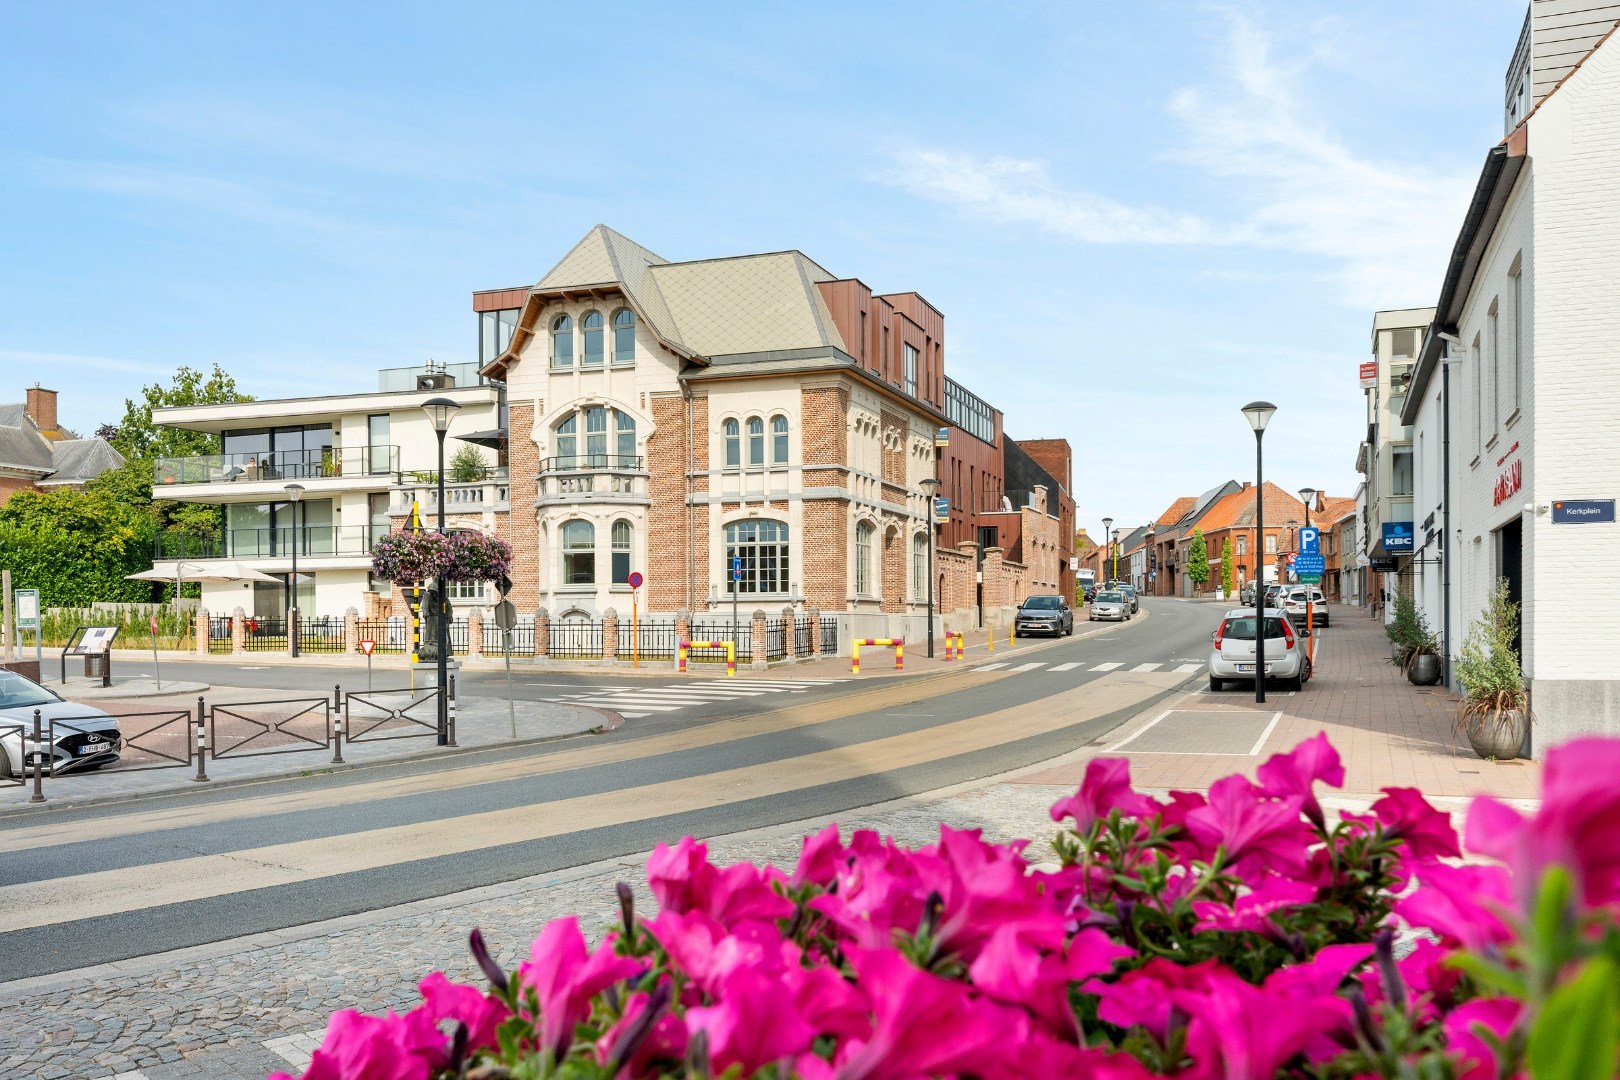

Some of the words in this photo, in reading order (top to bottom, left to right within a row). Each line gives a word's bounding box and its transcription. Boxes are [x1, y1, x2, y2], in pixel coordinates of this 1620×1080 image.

[1566, 507, 1601, 515] Kerkplein
[1301, 529, 1316, 550] P
[1385, 537, 1412, 546] KBC
